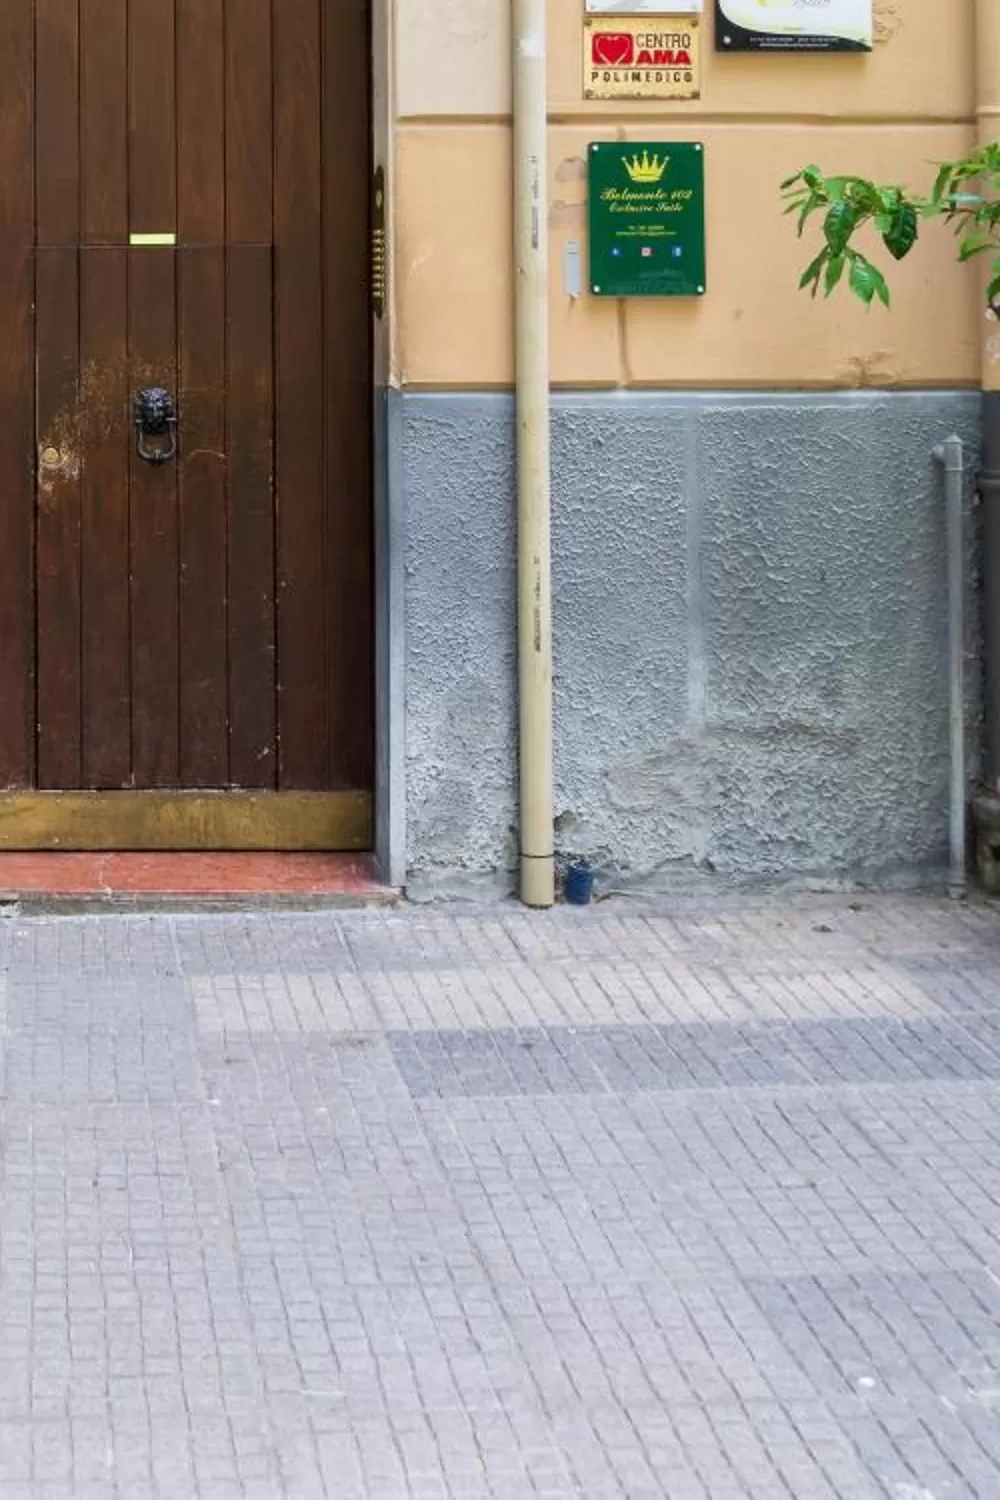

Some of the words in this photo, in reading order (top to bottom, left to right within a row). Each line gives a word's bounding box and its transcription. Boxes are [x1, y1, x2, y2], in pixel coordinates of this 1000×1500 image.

[636, 33, 691, 48] CENTRO
[636, 50, 691, 65] AMA
[591, 72, 692, 83] POLIMEDICO
